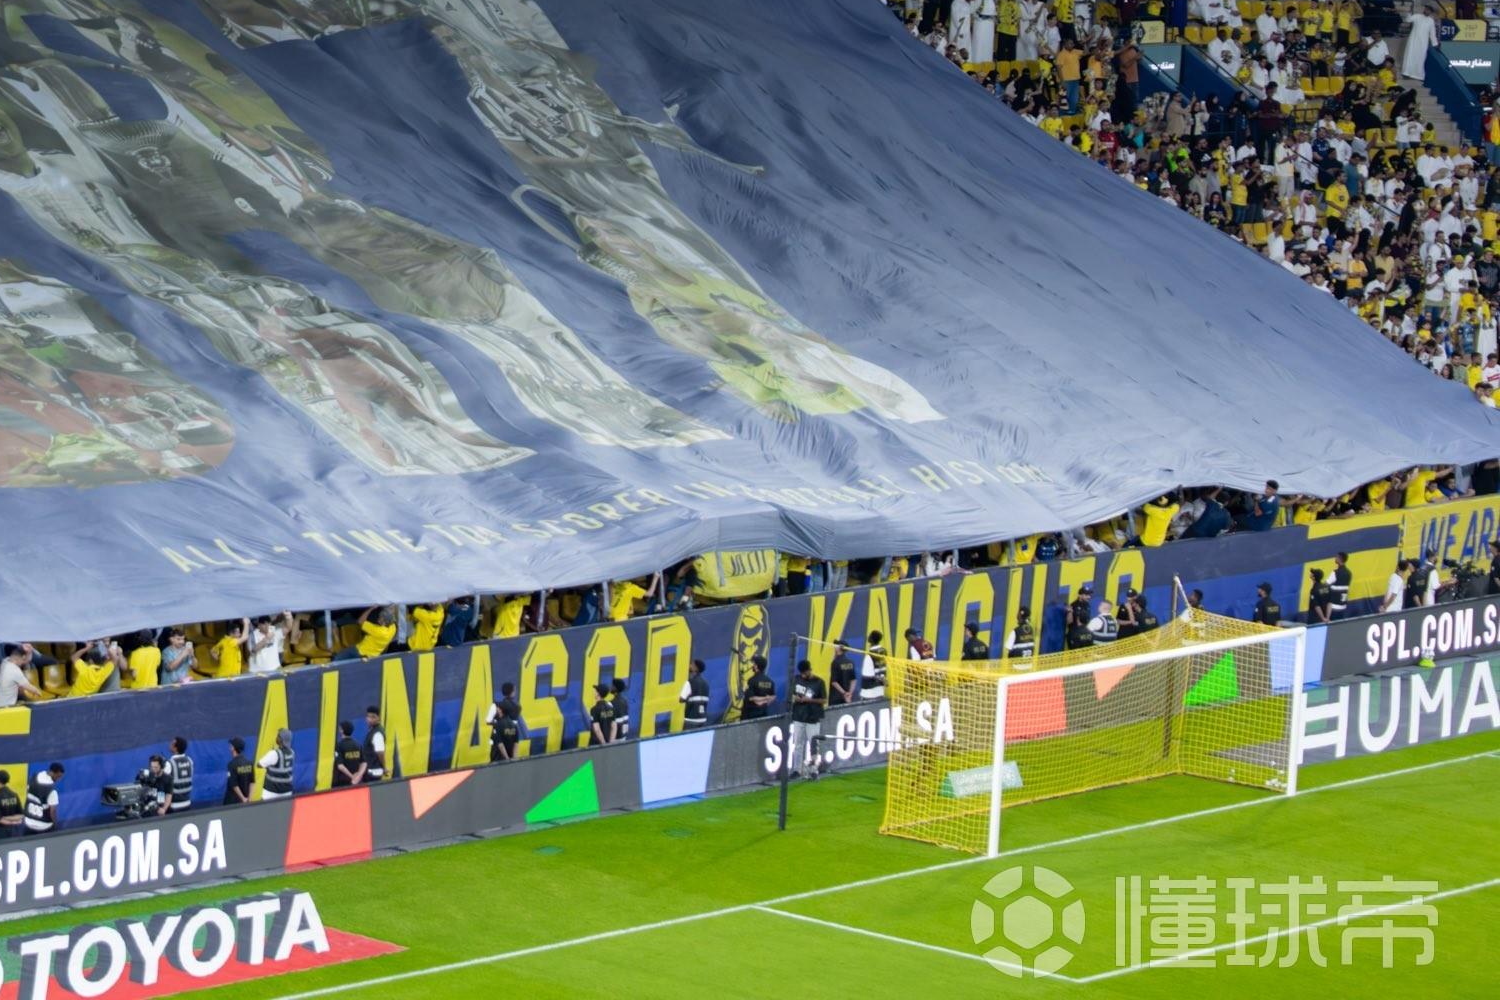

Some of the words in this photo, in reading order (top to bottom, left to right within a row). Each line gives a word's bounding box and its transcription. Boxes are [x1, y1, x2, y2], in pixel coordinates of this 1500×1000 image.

[510, 487, 675, 540] SCORER
[1418, 511, 1461, 570] WE
[1459, 506, 1500, 566] AR
[1366, 604, 1500, 666] SPL.COM.S
[10, 890, 331, 1000] TOYOTA
